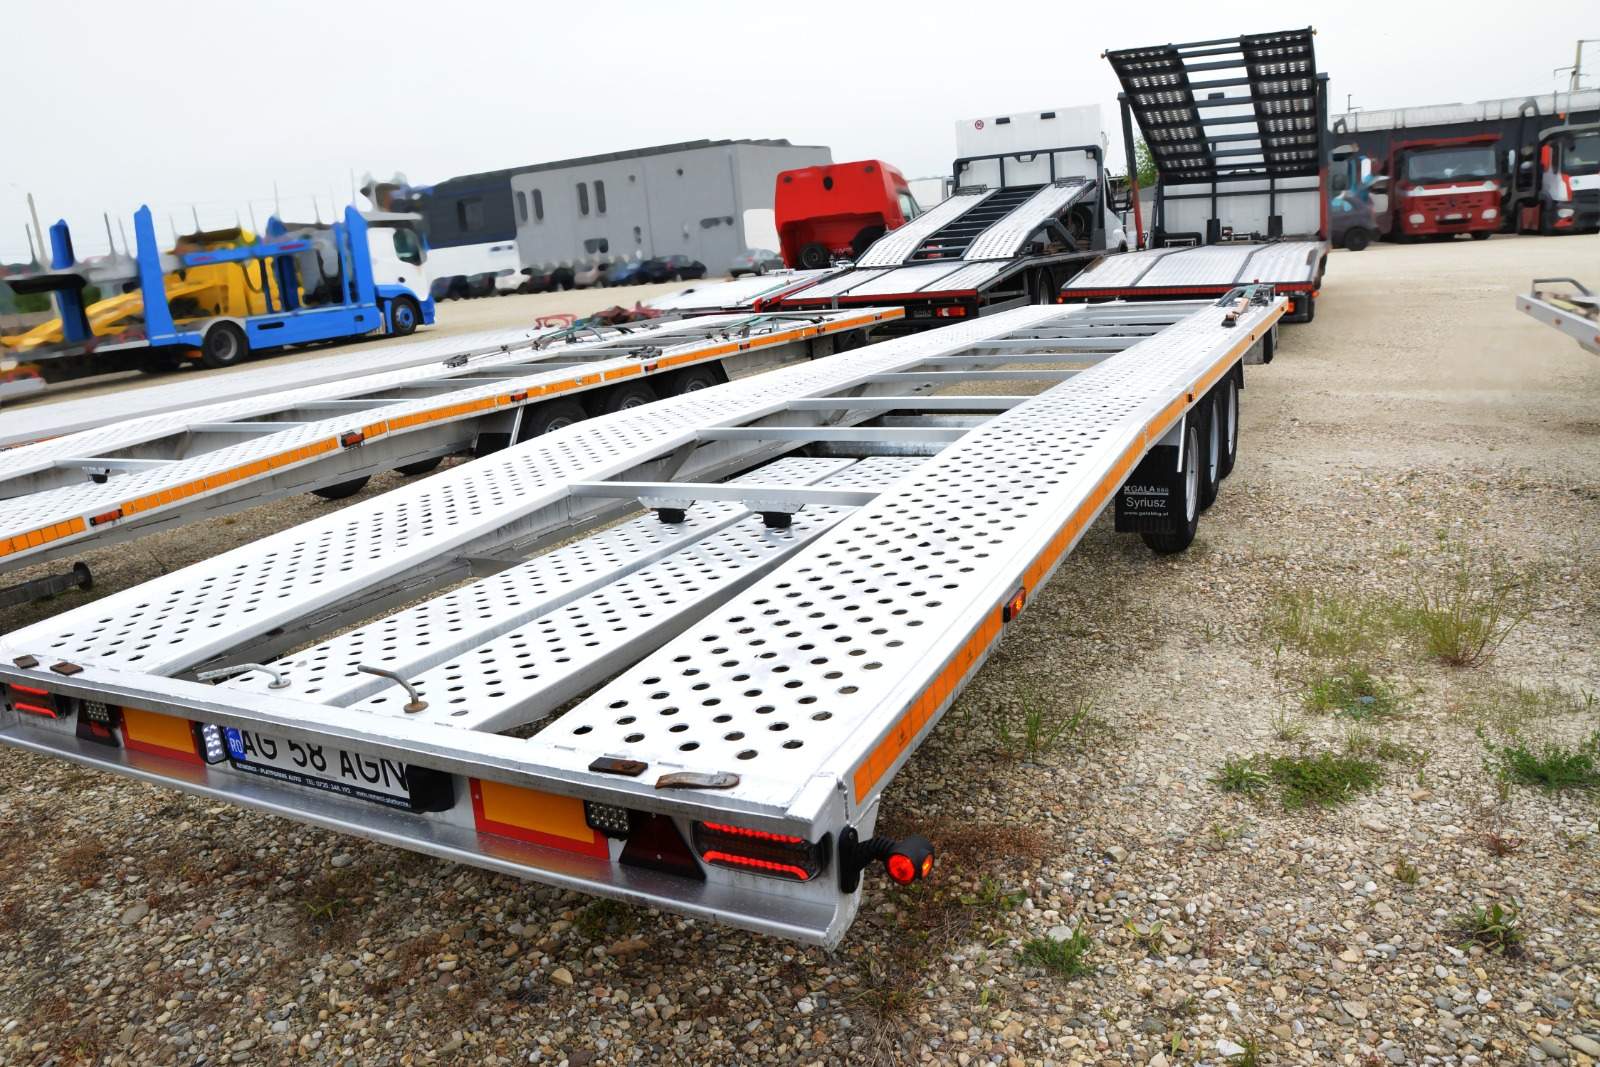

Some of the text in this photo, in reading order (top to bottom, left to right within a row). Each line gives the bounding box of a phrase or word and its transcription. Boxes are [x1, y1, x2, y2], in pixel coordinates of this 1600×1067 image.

[230, 738, 243, 753] RO
[242, 730, 408, 791] AG 58 AGN
